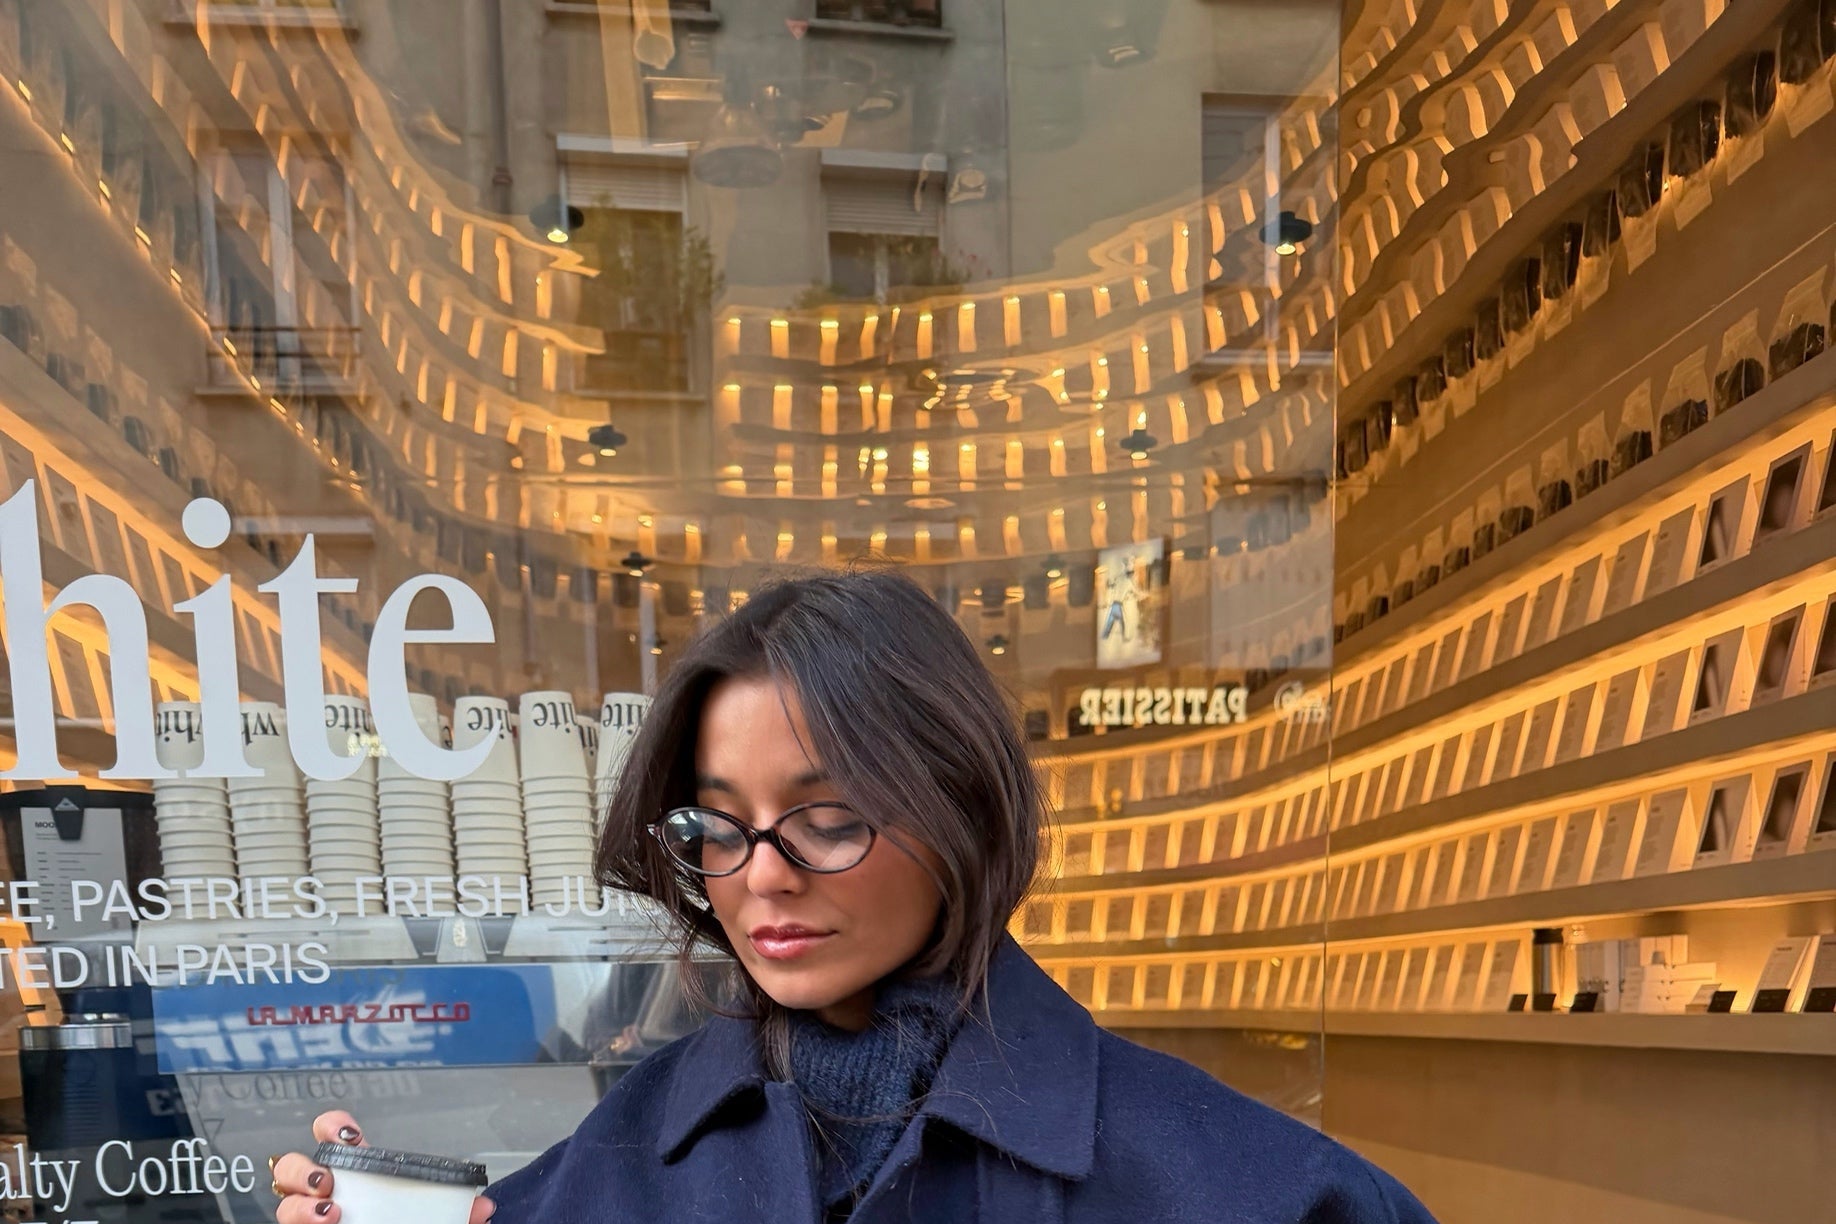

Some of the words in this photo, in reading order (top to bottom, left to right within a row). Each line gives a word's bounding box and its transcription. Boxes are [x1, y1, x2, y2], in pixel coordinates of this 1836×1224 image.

[71, 876, 339, 926] PASTRIES,
[355, 875, 530, 918] FRESH
[105, 945, 158, 987] IN
[177, 941, 331, 987] PARIS
[95, 1137, 256, 1197] Coffee
